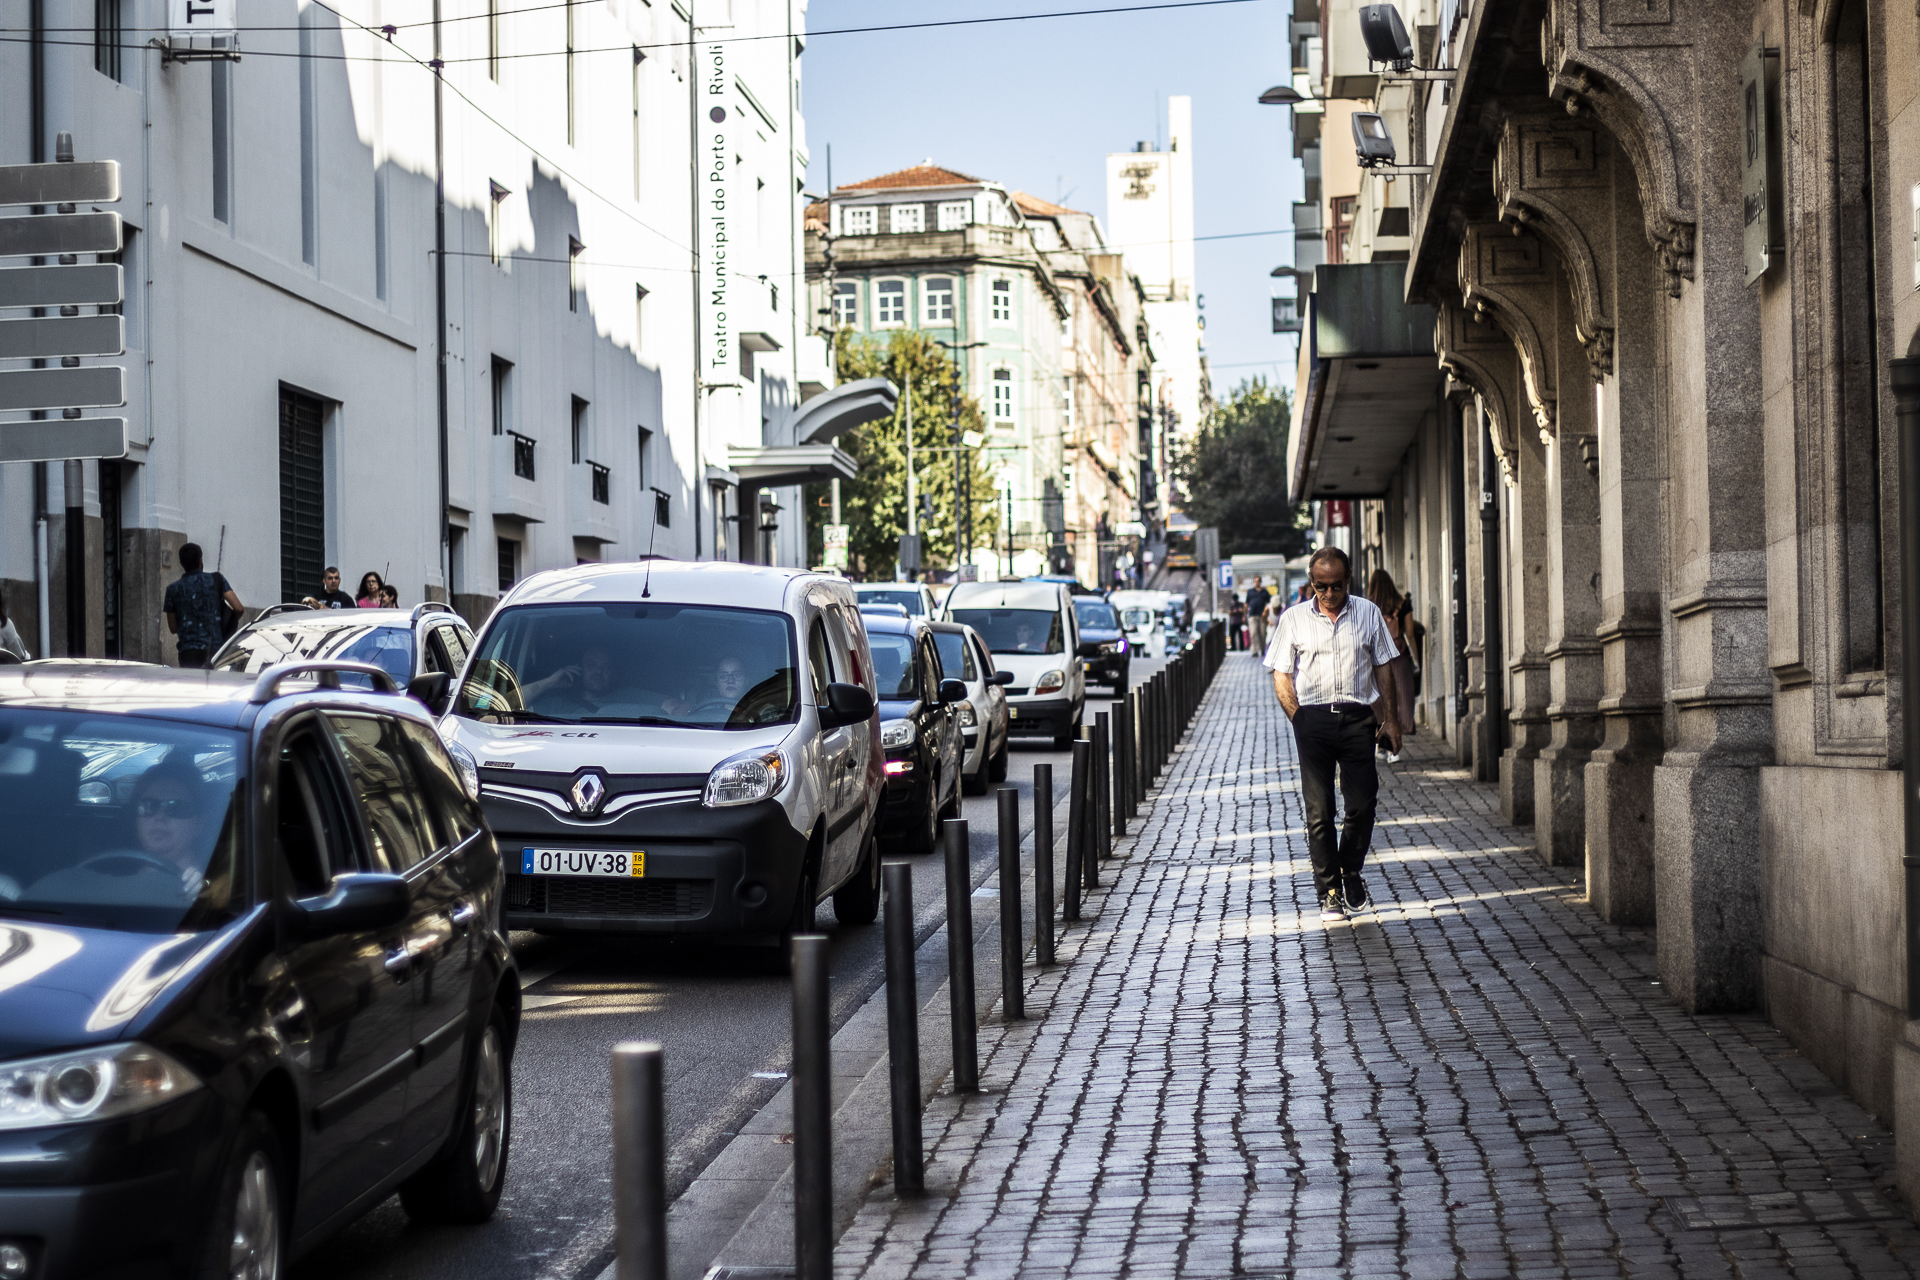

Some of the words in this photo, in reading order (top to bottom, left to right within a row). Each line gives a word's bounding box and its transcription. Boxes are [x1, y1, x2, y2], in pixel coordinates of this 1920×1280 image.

[709, 45, 724, 95] Rivoli
[710, 134, 725, 182] Porto
[711, 187, 726, 212] do
[711, 216, 728, 307] Municipal
[711, 312, 727, 369] Teatro
[632, 867, 643, 875] 06
[634, 854, 643, 862] 18
